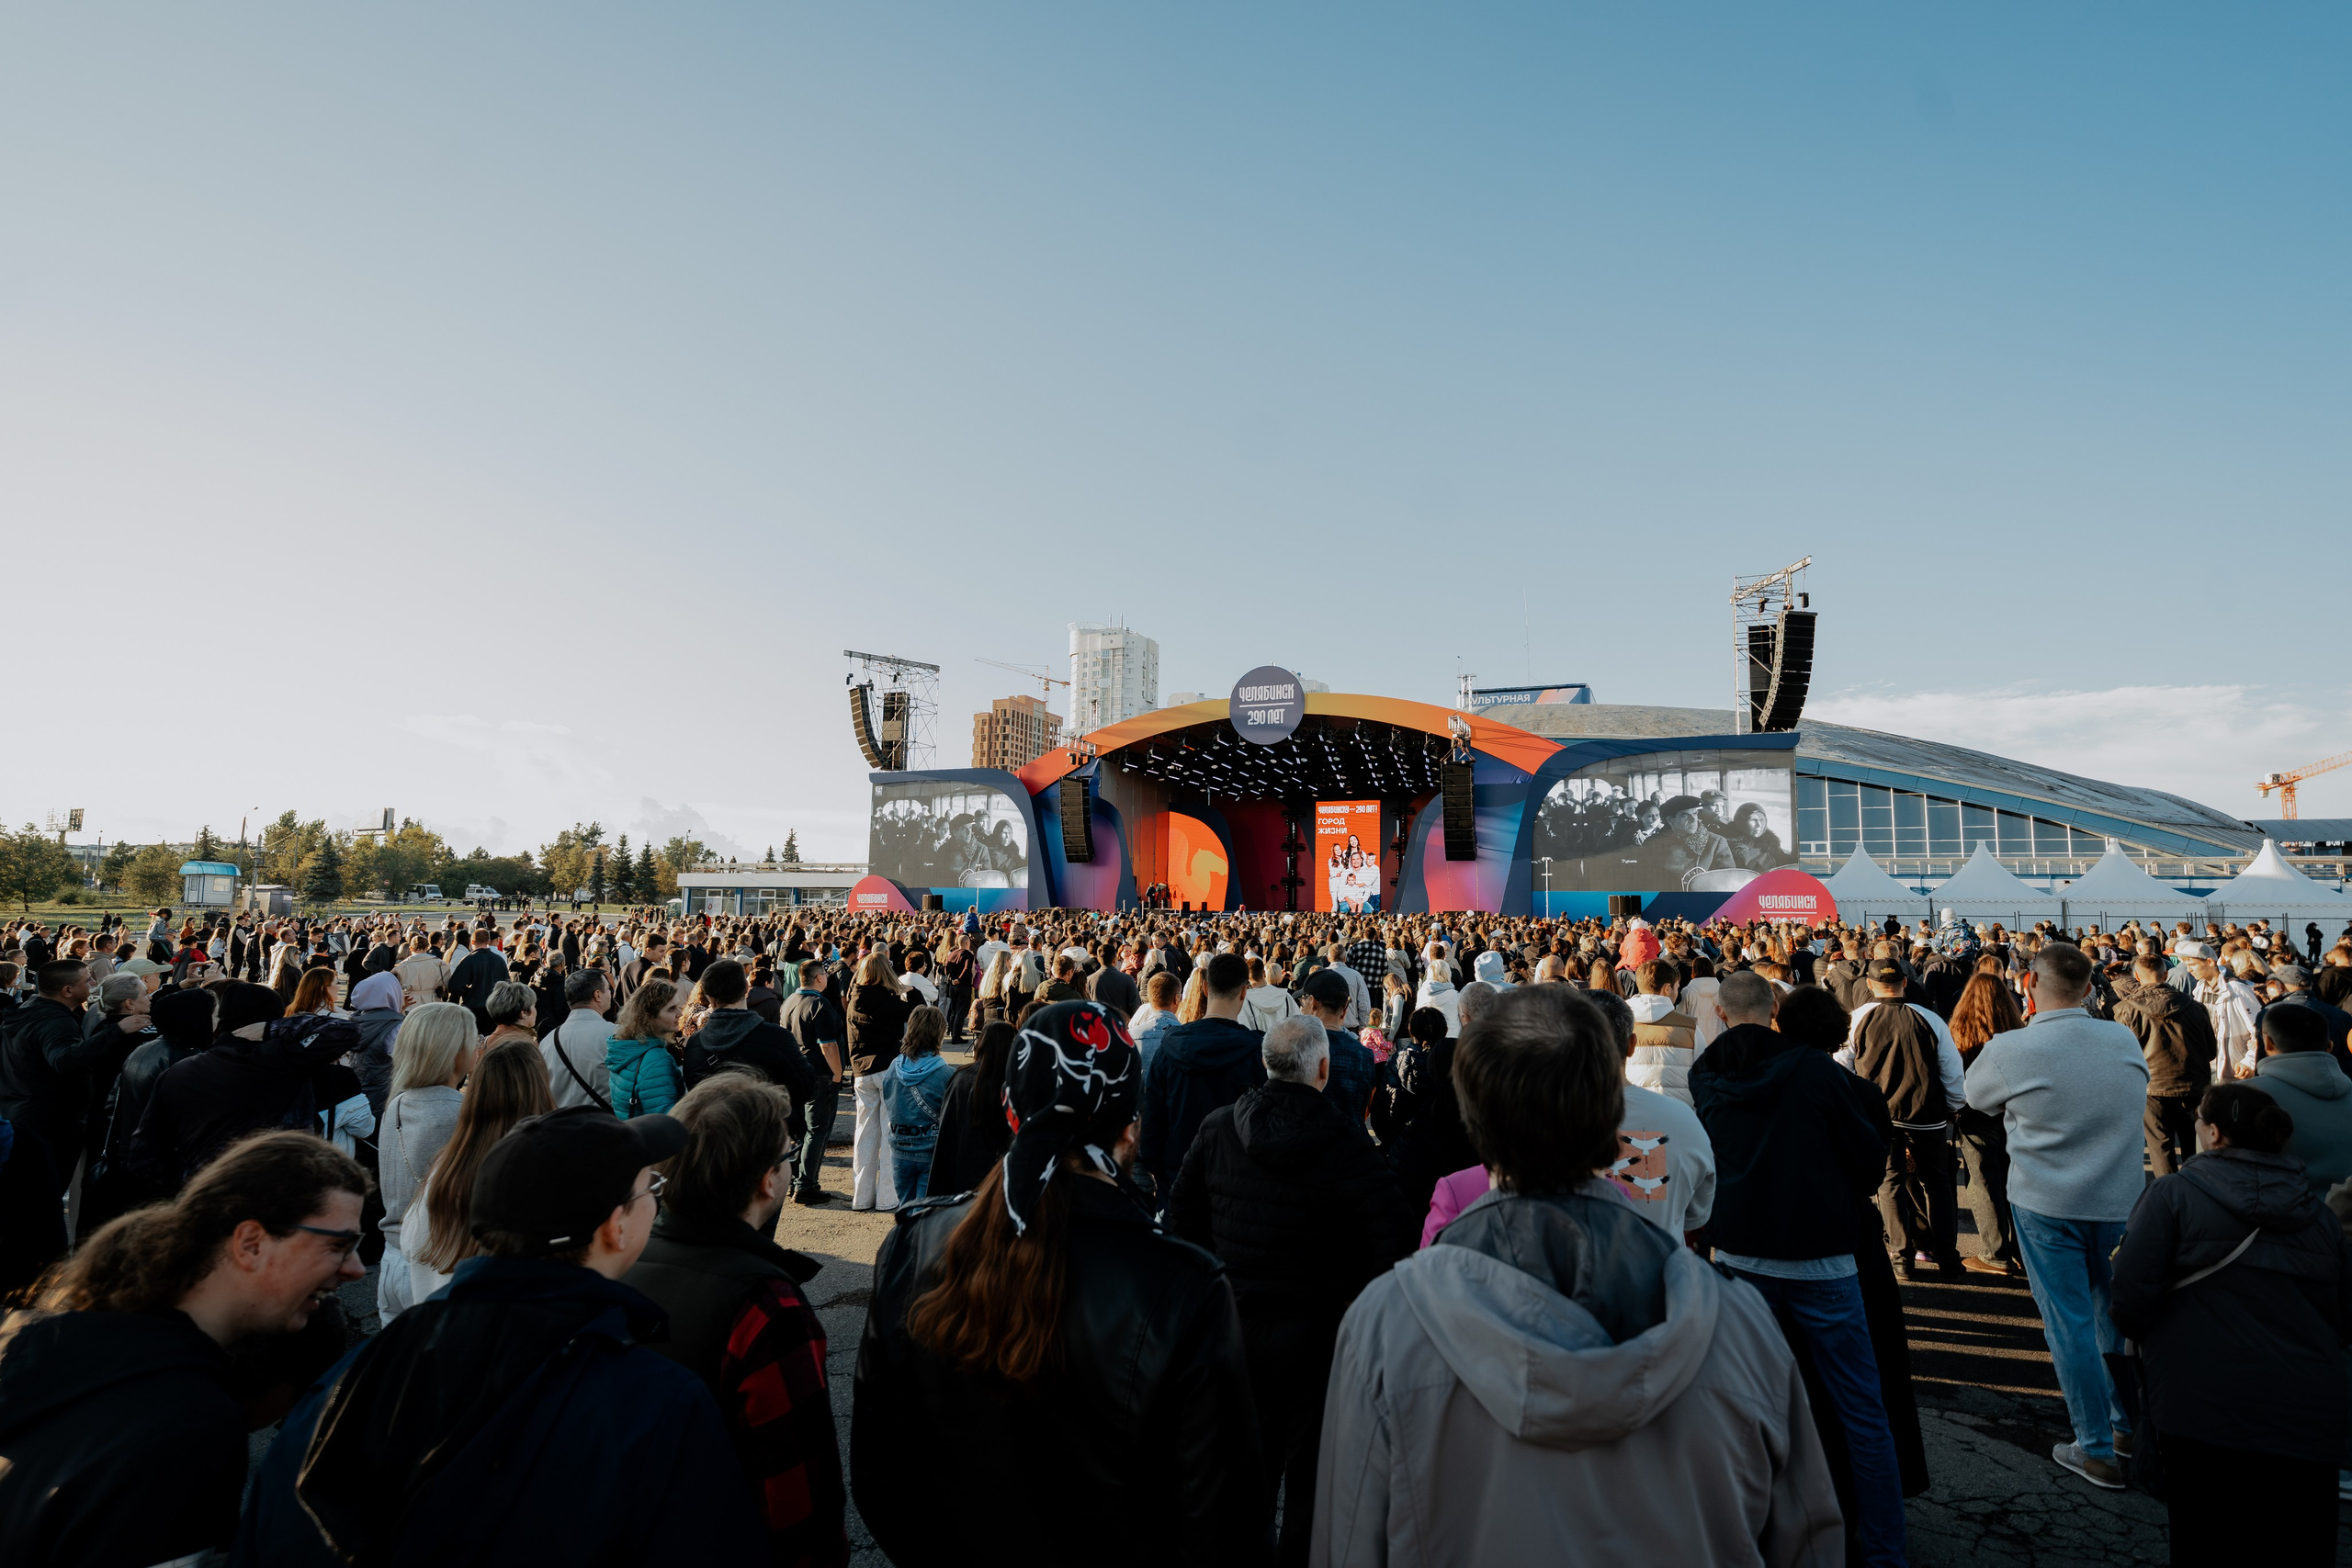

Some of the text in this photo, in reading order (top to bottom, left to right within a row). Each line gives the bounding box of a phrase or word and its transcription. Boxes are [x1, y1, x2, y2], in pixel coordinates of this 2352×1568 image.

[1238, 683, 1295, 702] ЧЕЛЯБИНСК
[1247, 708, 1285, 726] 290 ЛЕТ
[1317, 818, 1346, 826] ГОРОД
[1317, 827, 1348, 835] ЖИЗНИ
[1758, 895, 1817, 909] ЧЕЛЯБИНСК
